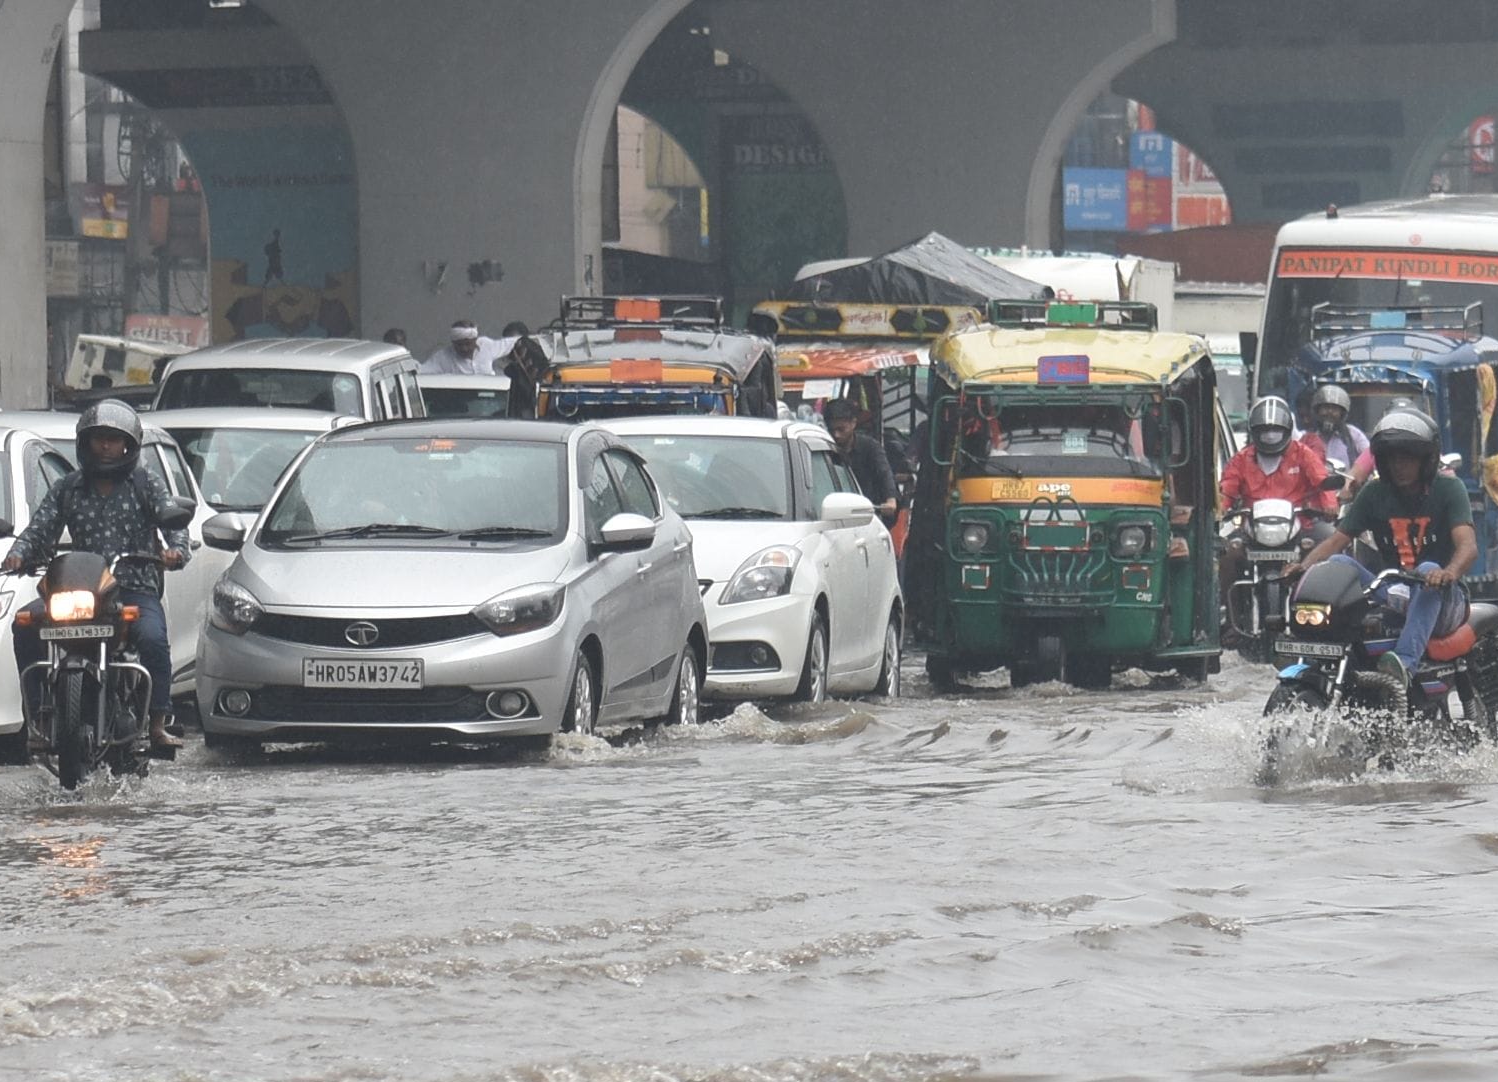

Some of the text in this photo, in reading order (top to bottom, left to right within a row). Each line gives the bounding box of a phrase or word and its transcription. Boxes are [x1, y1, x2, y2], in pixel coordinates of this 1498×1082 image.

[1282, 257, 1366, 273] PANIPAT
[1373, 259, 1450, 275] KUNDLI
[130, 327, 192, 346] GUEST
[1037, 483, 1071, 493] ape
[1135, 592, 1153, 602] CNG
[314, 663, 421, 684] HR05AW3742
